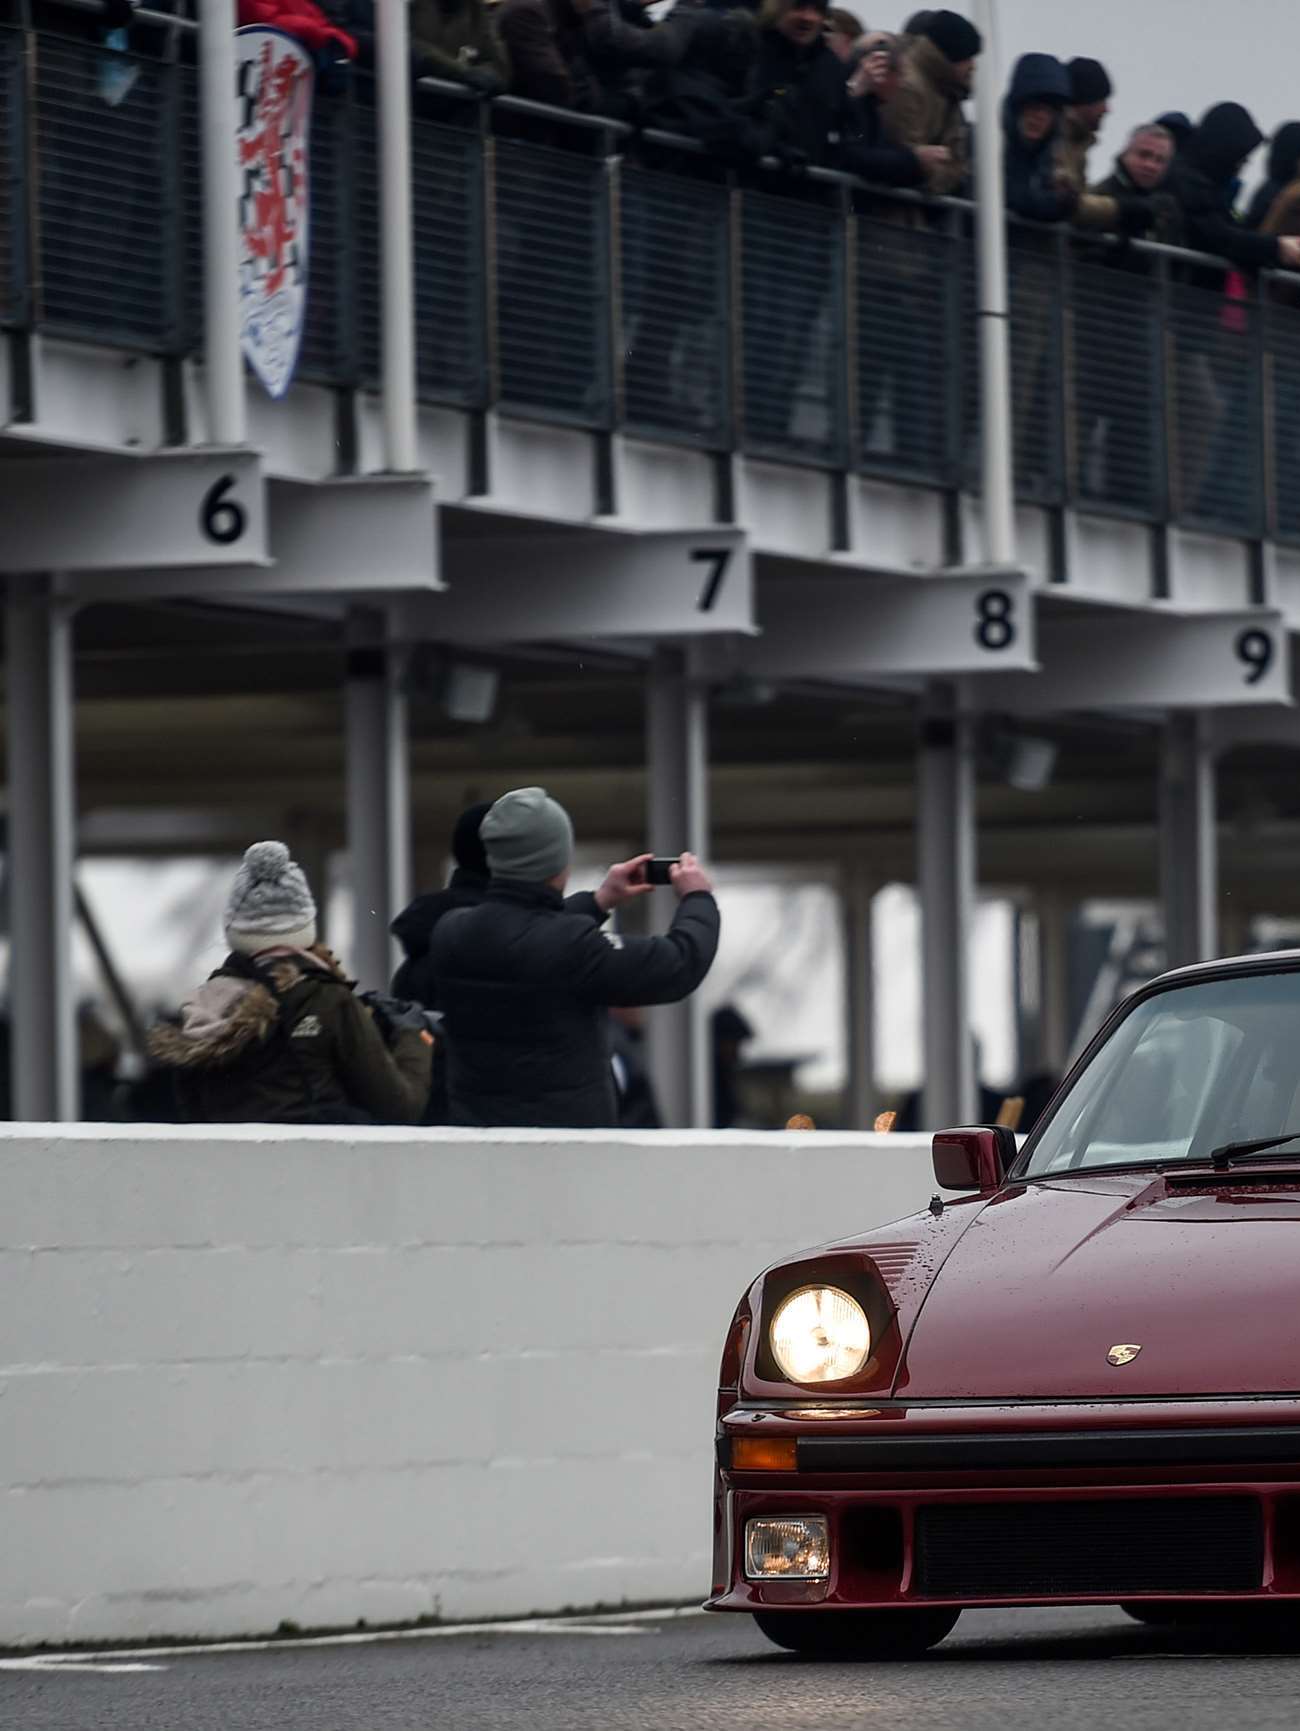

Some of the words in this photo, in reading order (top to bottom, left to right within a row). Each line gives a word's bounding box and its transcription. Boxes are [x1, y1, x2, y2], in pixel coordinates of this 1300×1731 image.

[201, 475, 246, 545] 6
[691, 549, 732, 611] 7
[975, 590, 1015, 650] 8
[1235, 628, 1274, 684] 9
